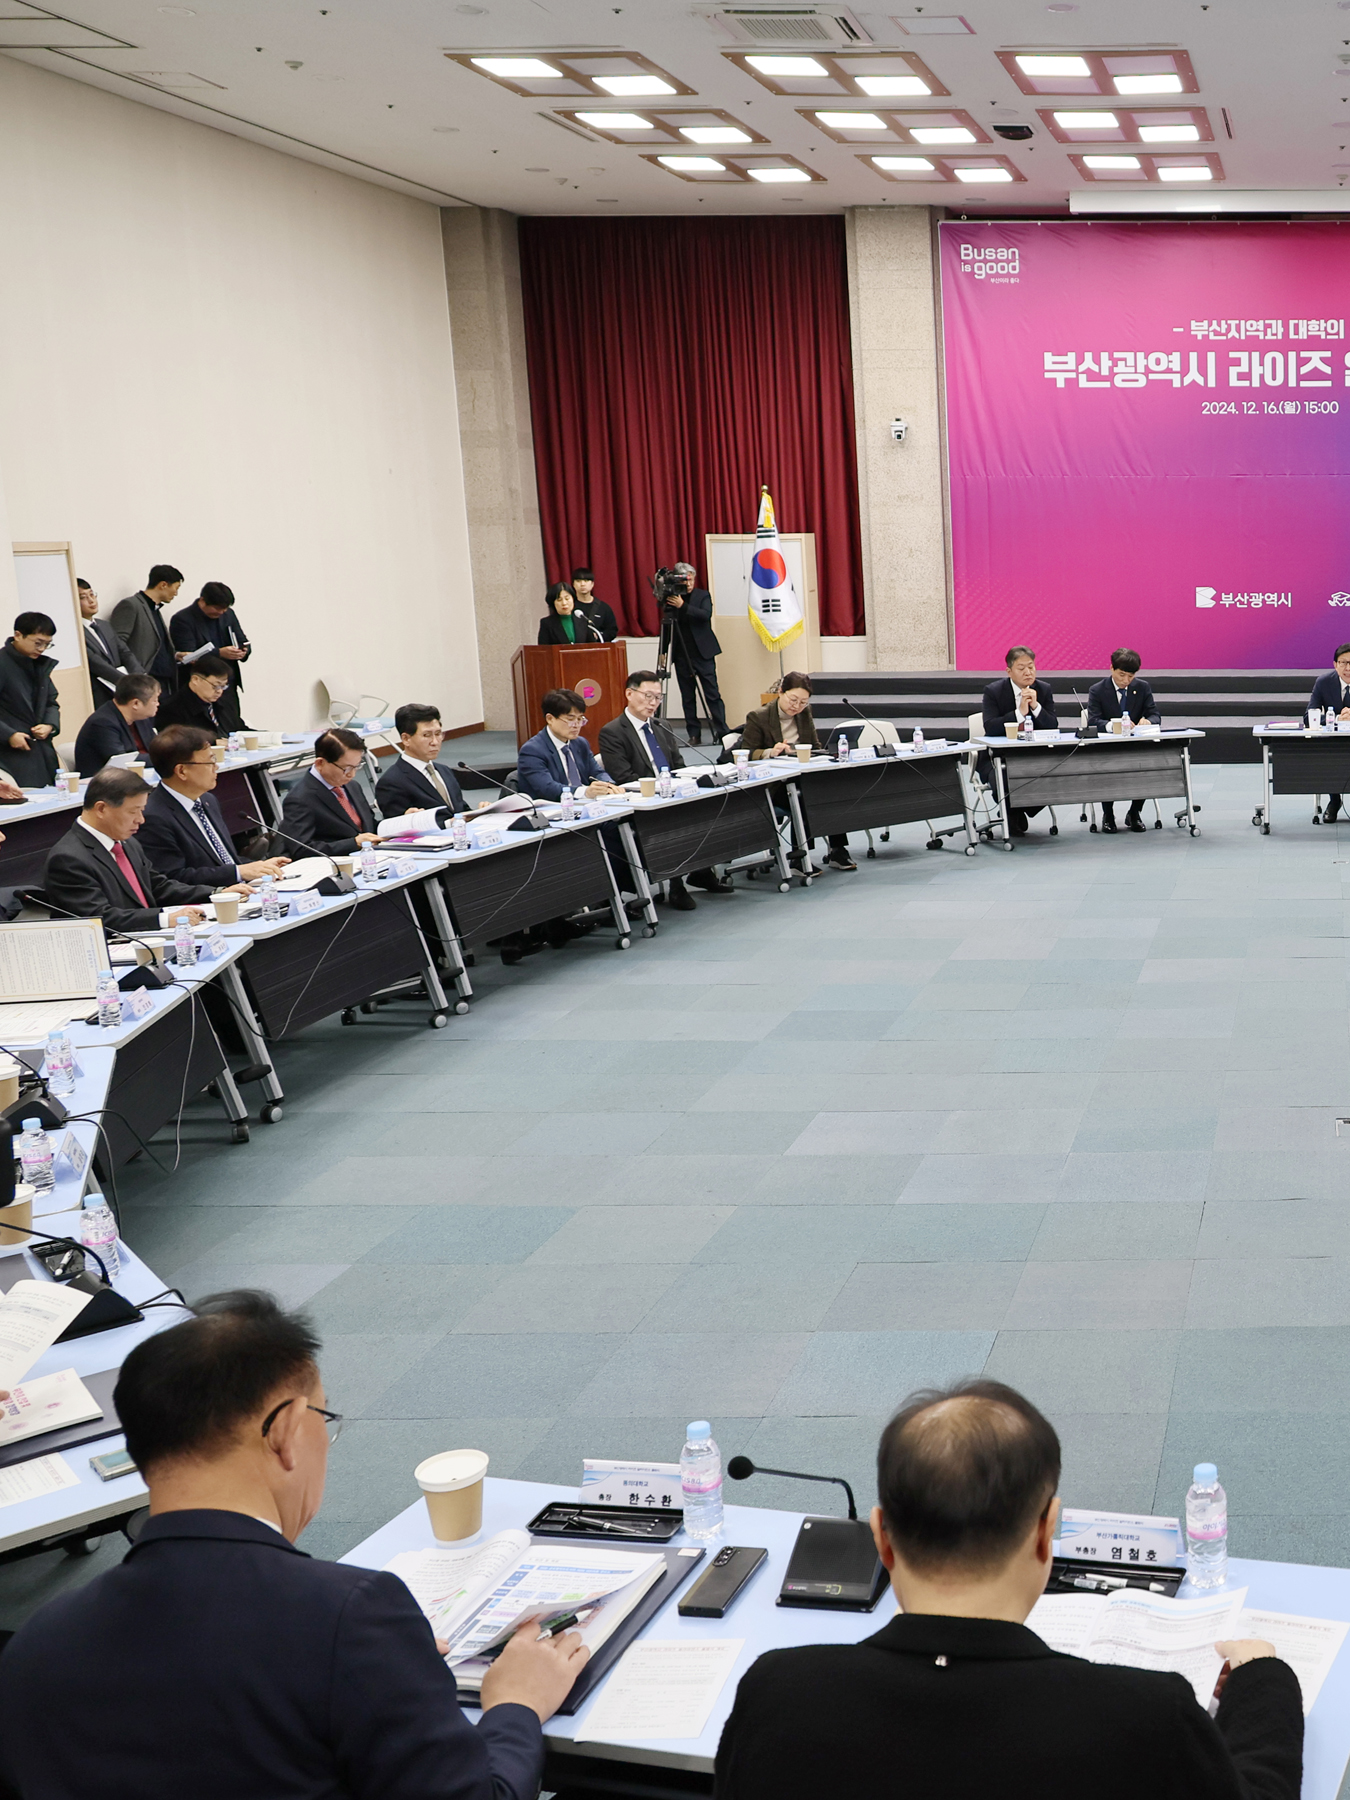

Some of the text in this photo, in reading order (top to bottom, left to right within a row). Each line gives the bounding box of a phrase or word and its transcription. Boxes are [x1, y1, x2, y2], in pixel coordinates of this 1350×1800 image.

[961, 244, 1019, 260] Busan
[961, 259, 1020, 279] is good
[1190, 320, 1284, 340] 부산지역과
[1289, 318, 1345, 339] 대학의
[1043, 351, 1215, 388] 부산광역시
[1228, 350, 1332, 387] 라이즈
[1201, 402, 1239, 415] 2024.
[1242, 402, 1259, 415] 12.
[1262, 401, 1301, 415] 16.(월)
[1304, 401, 1339, 414] 15:00
[1220, 592, 1292, 608] 부산광역시
[622, 1479, 649, 1488] 동의대학교
[598, 1492, 672, 1507] 총장 한수환
[1075, 1546, 1158, 1563] 부총장 염철호
